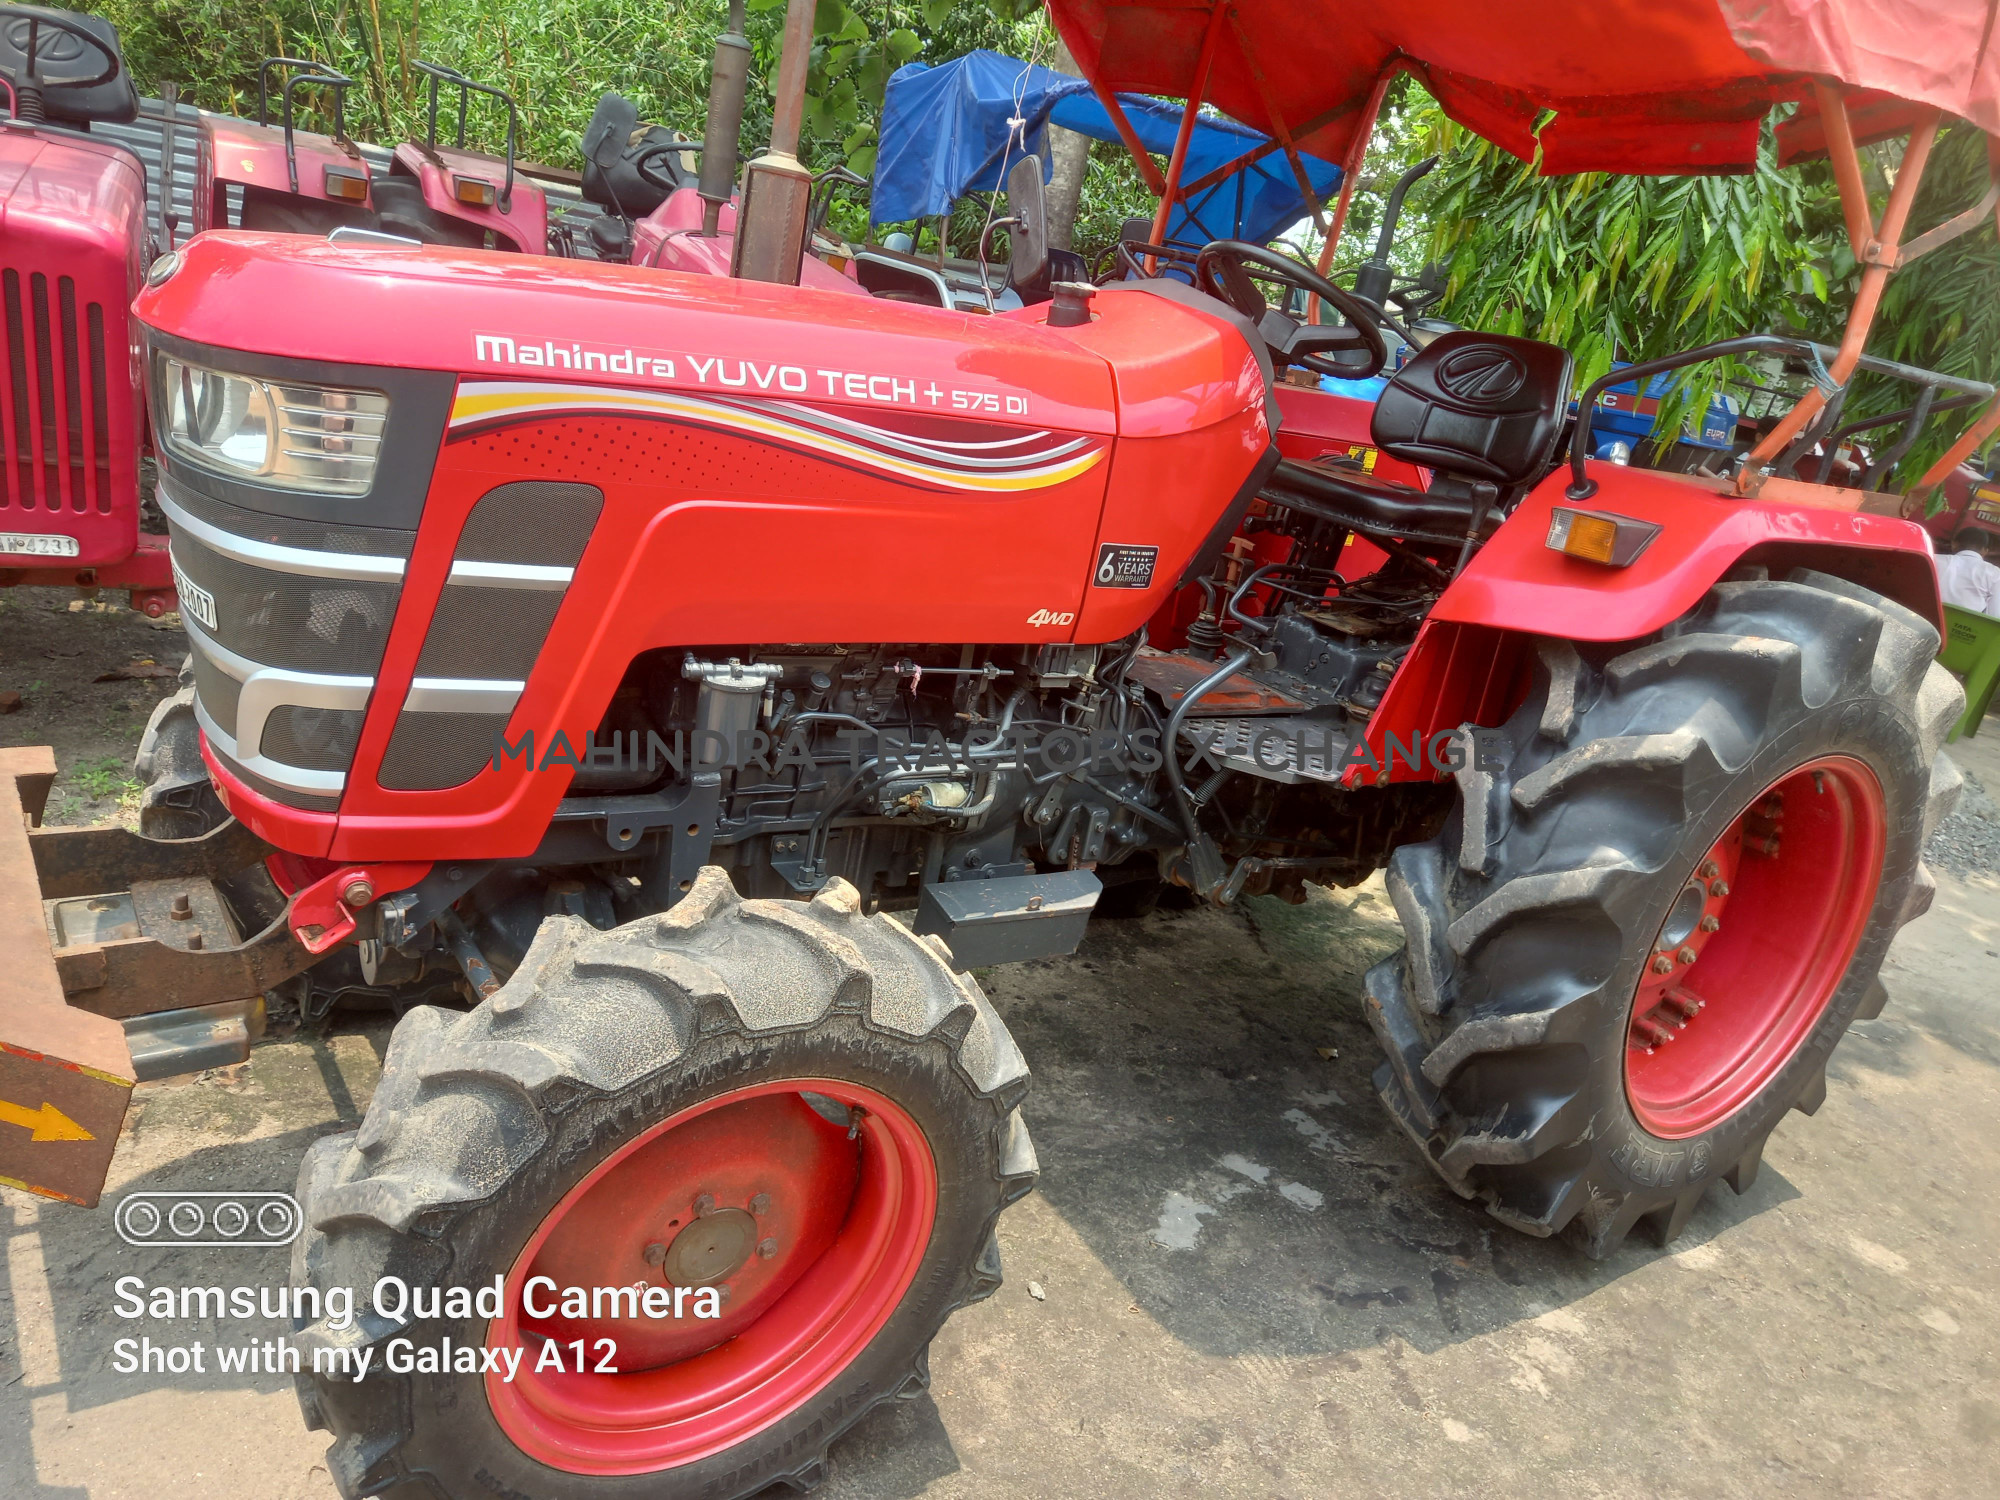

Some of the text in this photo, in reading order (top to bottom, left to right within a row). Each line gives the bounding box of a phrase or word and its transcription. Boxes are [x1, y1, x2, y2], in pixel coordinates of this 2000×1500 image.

[475, 334, 676, 379] Mahindra
[685, 355, 807, 393] YUVO
[951, 390, 1000, 412] 575
[1005, 395, 1028, 416] DI
[1705, 428, 1725, 440] EURO
[1098, 552, 1115, 583] 6
[1114, 574, 1149, 583] WARRANTY
[1026, 608, 1075, 628] 4WD
